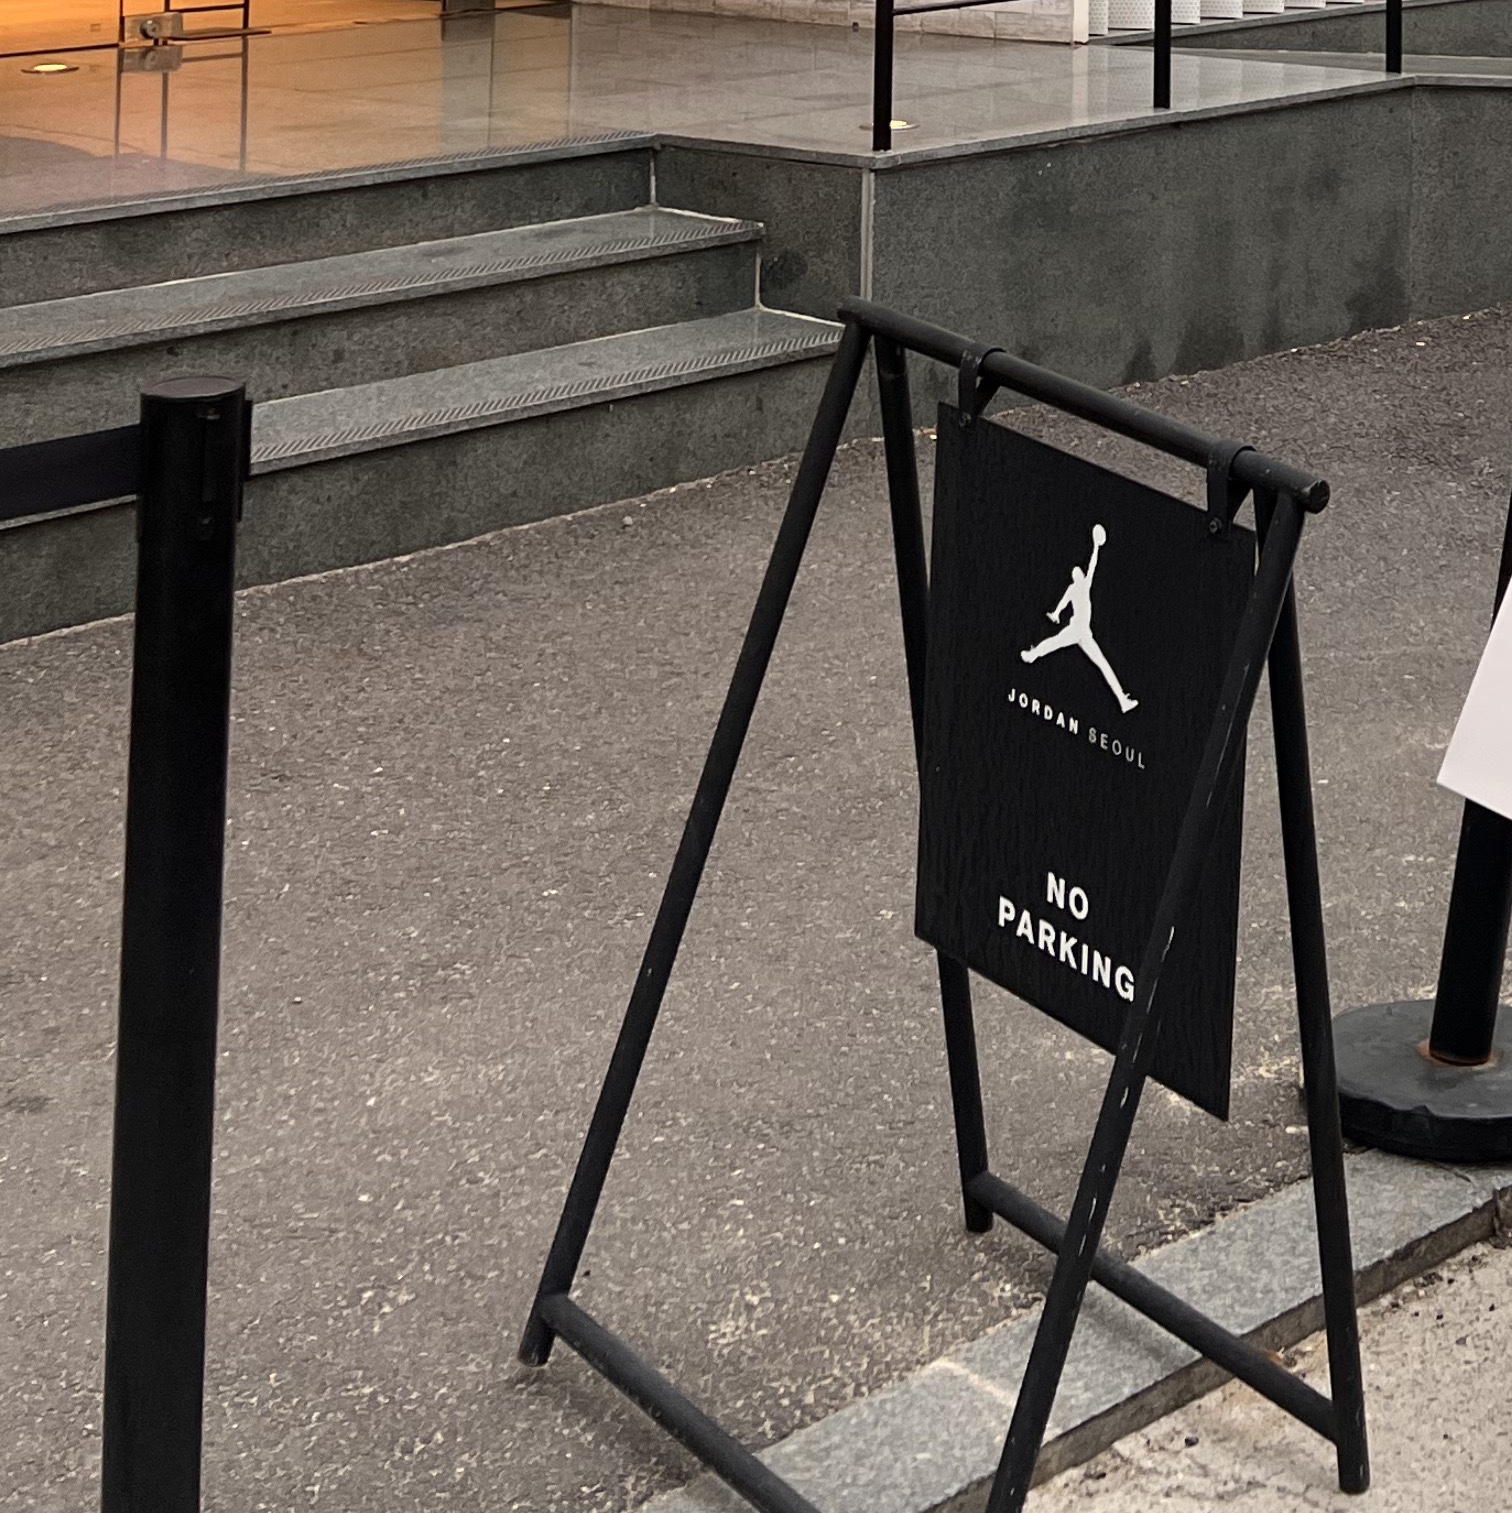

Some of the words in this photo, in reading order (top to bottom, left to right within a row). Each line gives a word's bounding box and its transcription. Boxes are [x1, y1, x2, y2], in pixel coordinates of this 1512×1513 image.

[1007, 687, 1079, 735] JORDAN
[1088, 726, 1145, 770] SEOUL
[1046, 871, 1089, 921] NO
[997, 895, 1136, 1003] PARKING
